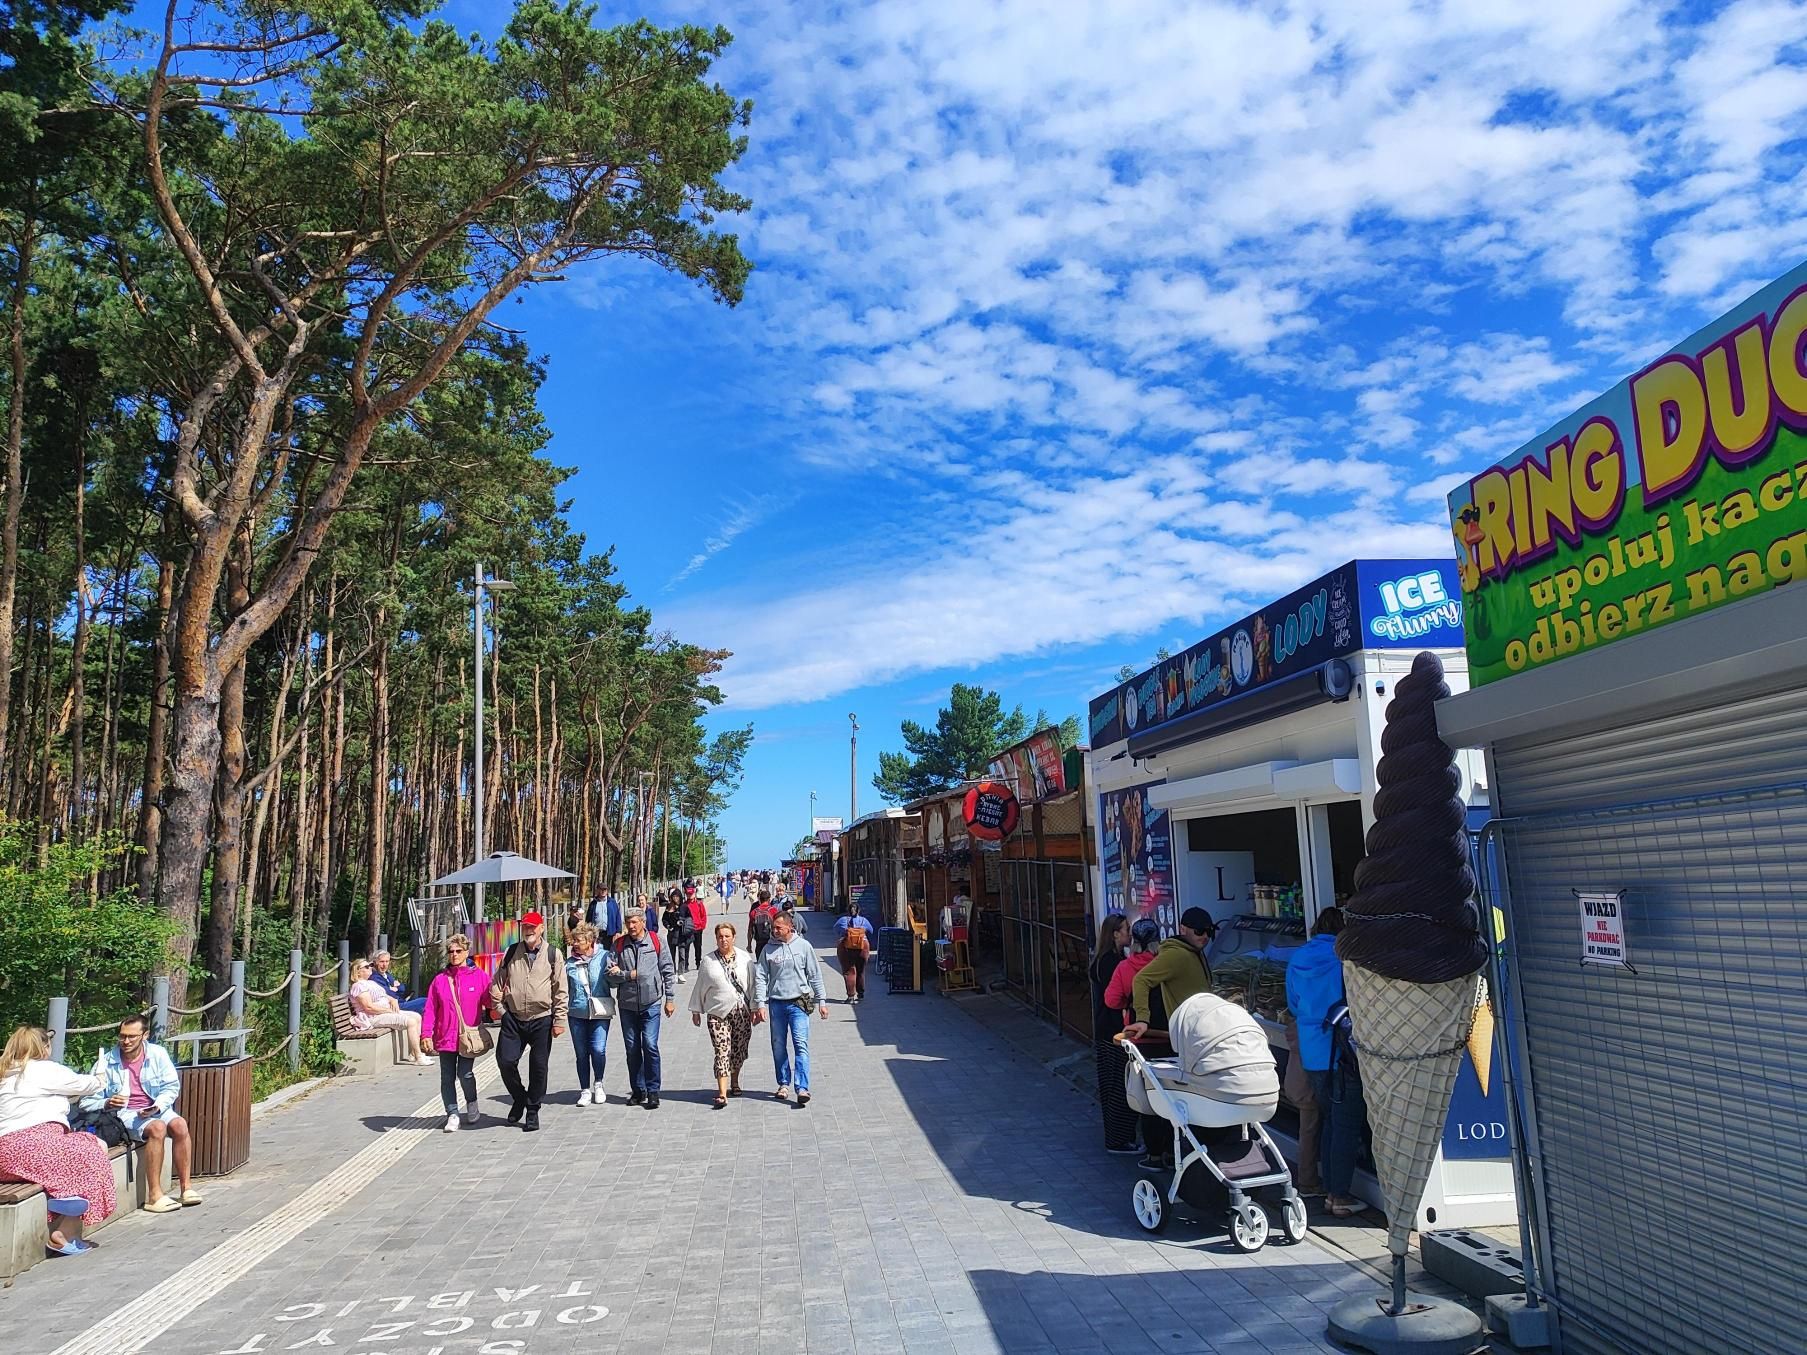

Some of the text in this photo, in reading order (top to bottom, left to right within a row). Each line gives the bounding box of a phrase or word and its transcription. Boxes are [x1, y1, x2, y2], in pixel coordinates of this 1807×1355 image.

[1471, 418, 1624, 577] RING
[1529, 512, 1675, 609] upoluj
[1380, 571, 1447, 614] ICE
[1275, 588, 1327, 664] LODY
[1372, 600, 1460, 639] Flurry
[1505, 582, 1674, 671] odbierz
[1584, 902, 1617, 917] WJAZD
[1597, 921, 1607, 931] NIE
[1588, 945, 1620, 957] NO PARKING
[1457, 1123, 1505, 1140] LOD
[274, 1280, 592, 1322] TABLIC
